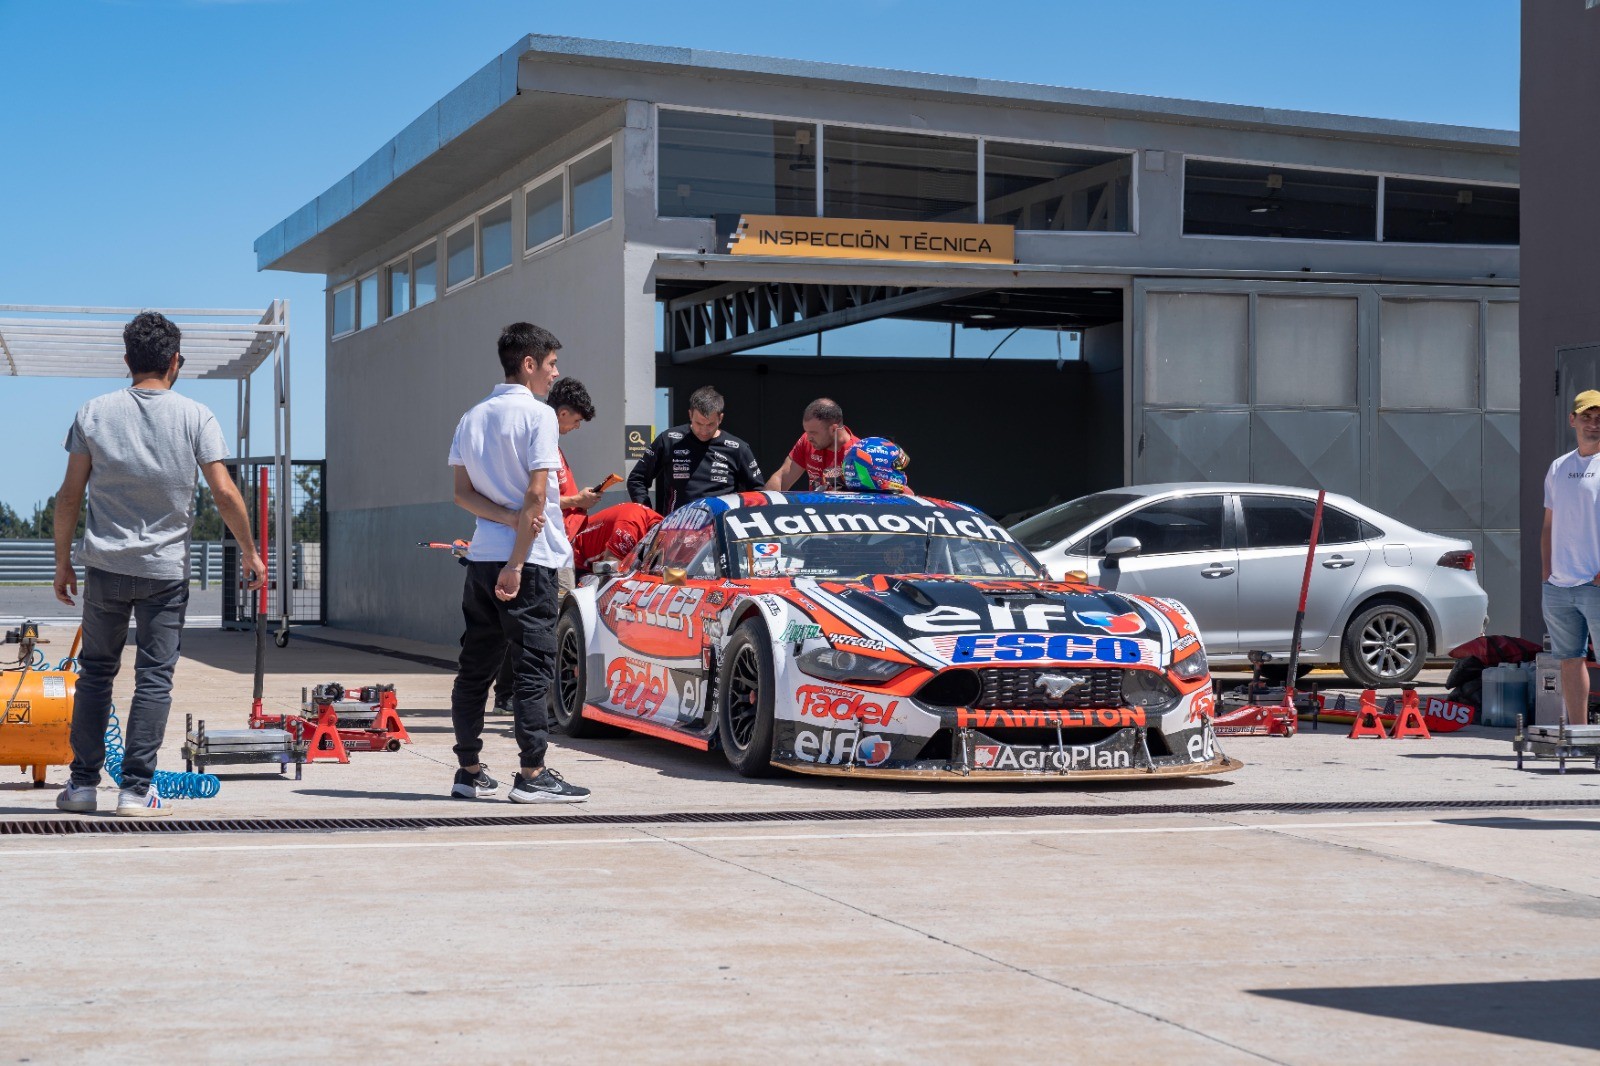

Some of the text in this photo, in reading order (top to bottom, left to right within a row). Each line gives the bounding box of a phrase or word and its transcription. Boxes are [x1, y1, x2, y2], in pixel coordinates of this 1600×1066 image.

[759, 229, 992, 253] INSPECCIÓN TÉCNICA
[725, 506, 1015, 543] Haimovich
[828, 633, 886, 652] INTEGRA
[951, 634, 1142, 663] ESCO
[796, 684, 899, 727] Fadel
[956, 706, 1147, 727] HAMILTON
[1428, 698, 1471, 724] RUS
[996, 745, 1130, 768] AgroPlan
